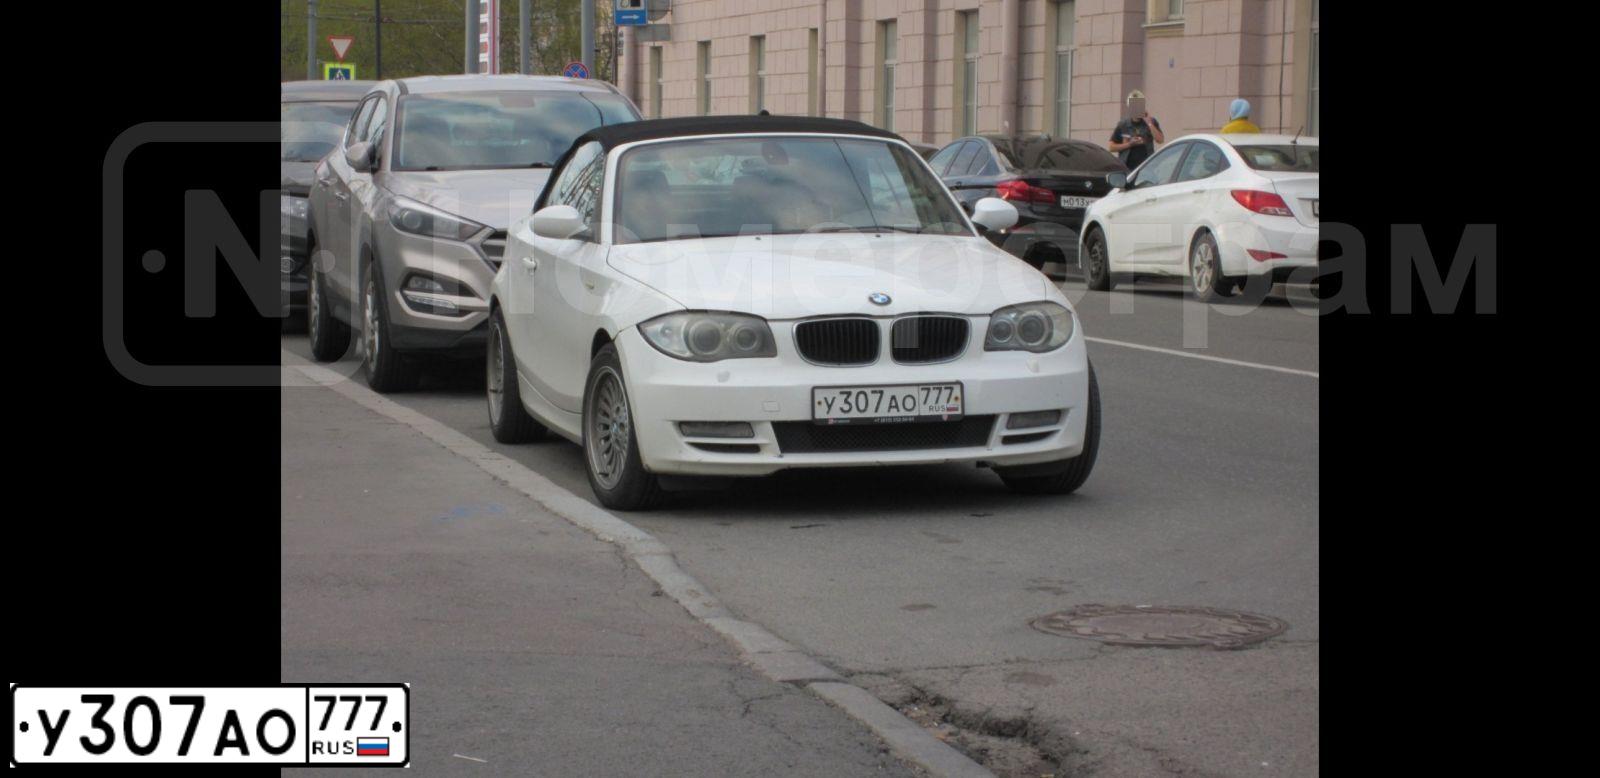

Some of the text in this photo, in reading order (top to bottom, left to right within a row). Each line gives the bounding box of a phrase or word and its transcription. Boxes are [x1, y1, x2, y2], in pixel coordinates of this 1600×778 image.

[824, 386, 954, 415] У307АО 777
[928, 404, 945, 412] RUS
